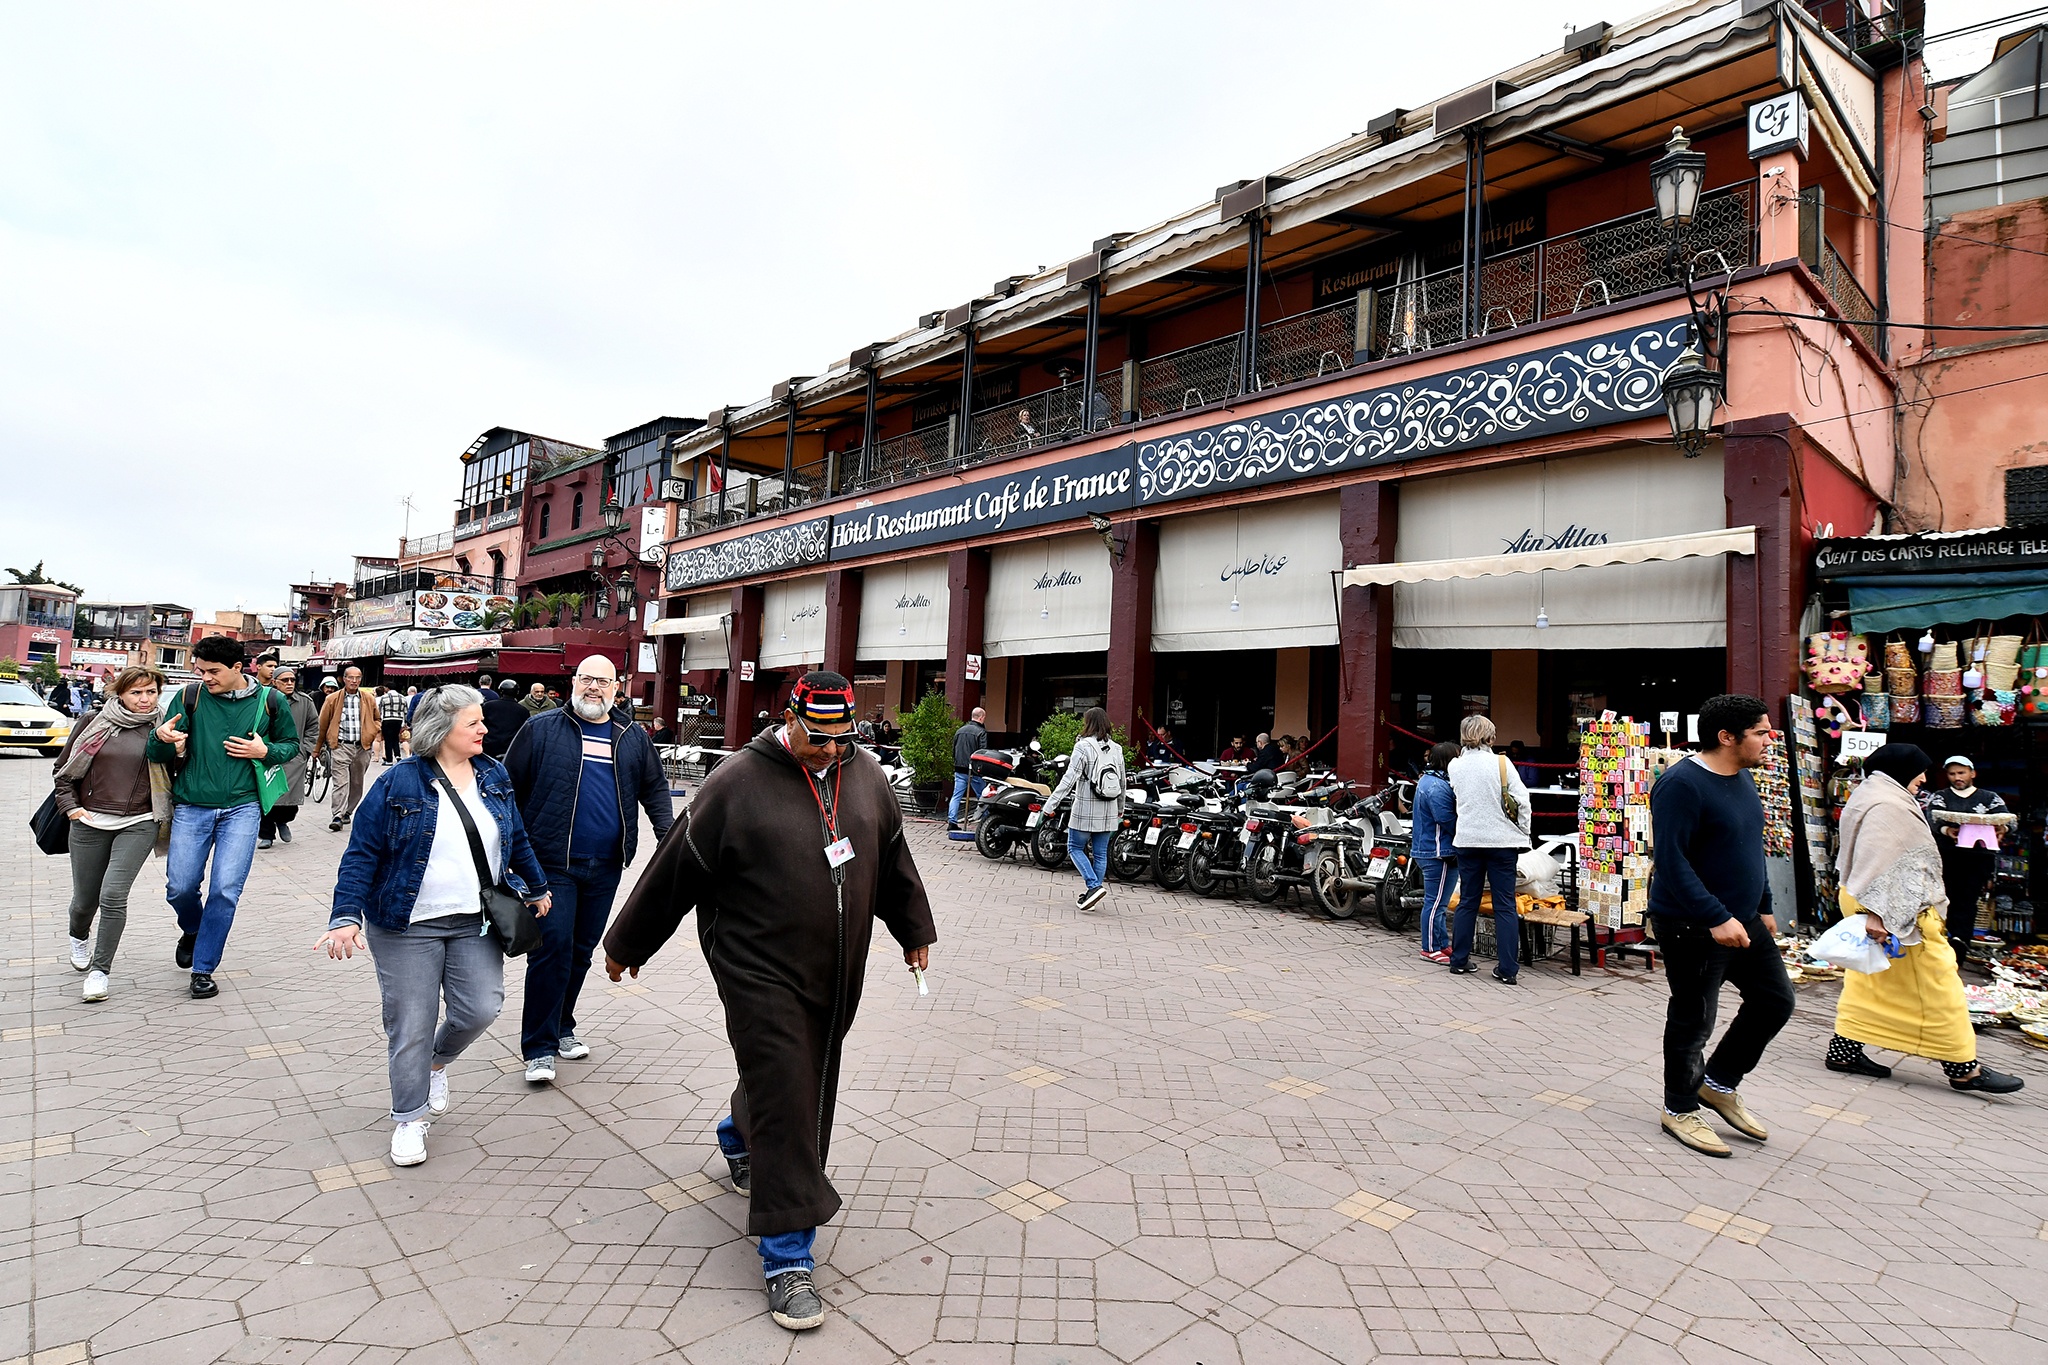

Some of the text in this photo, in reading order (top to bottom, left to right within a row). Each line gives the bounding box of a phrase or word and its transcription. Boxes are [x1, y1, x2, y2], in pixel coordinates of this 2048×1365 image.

[1755, 101, 1790, 137] CF
[1320, 256, 1400, 297] Restaurant
[831, 467, 1131, 549] Hôtel Restaurant Café de France
[1543, 524, 1608, 551] Atlas
[1862, 549, 1886, 562] DES
[1889, 545, 1934, 561] CARTS
[1938, 541, 2015, 559] RECHARGE
[1052, 569, 1081, 587] Atlas
[1604, 711, 1614, 721] 10
